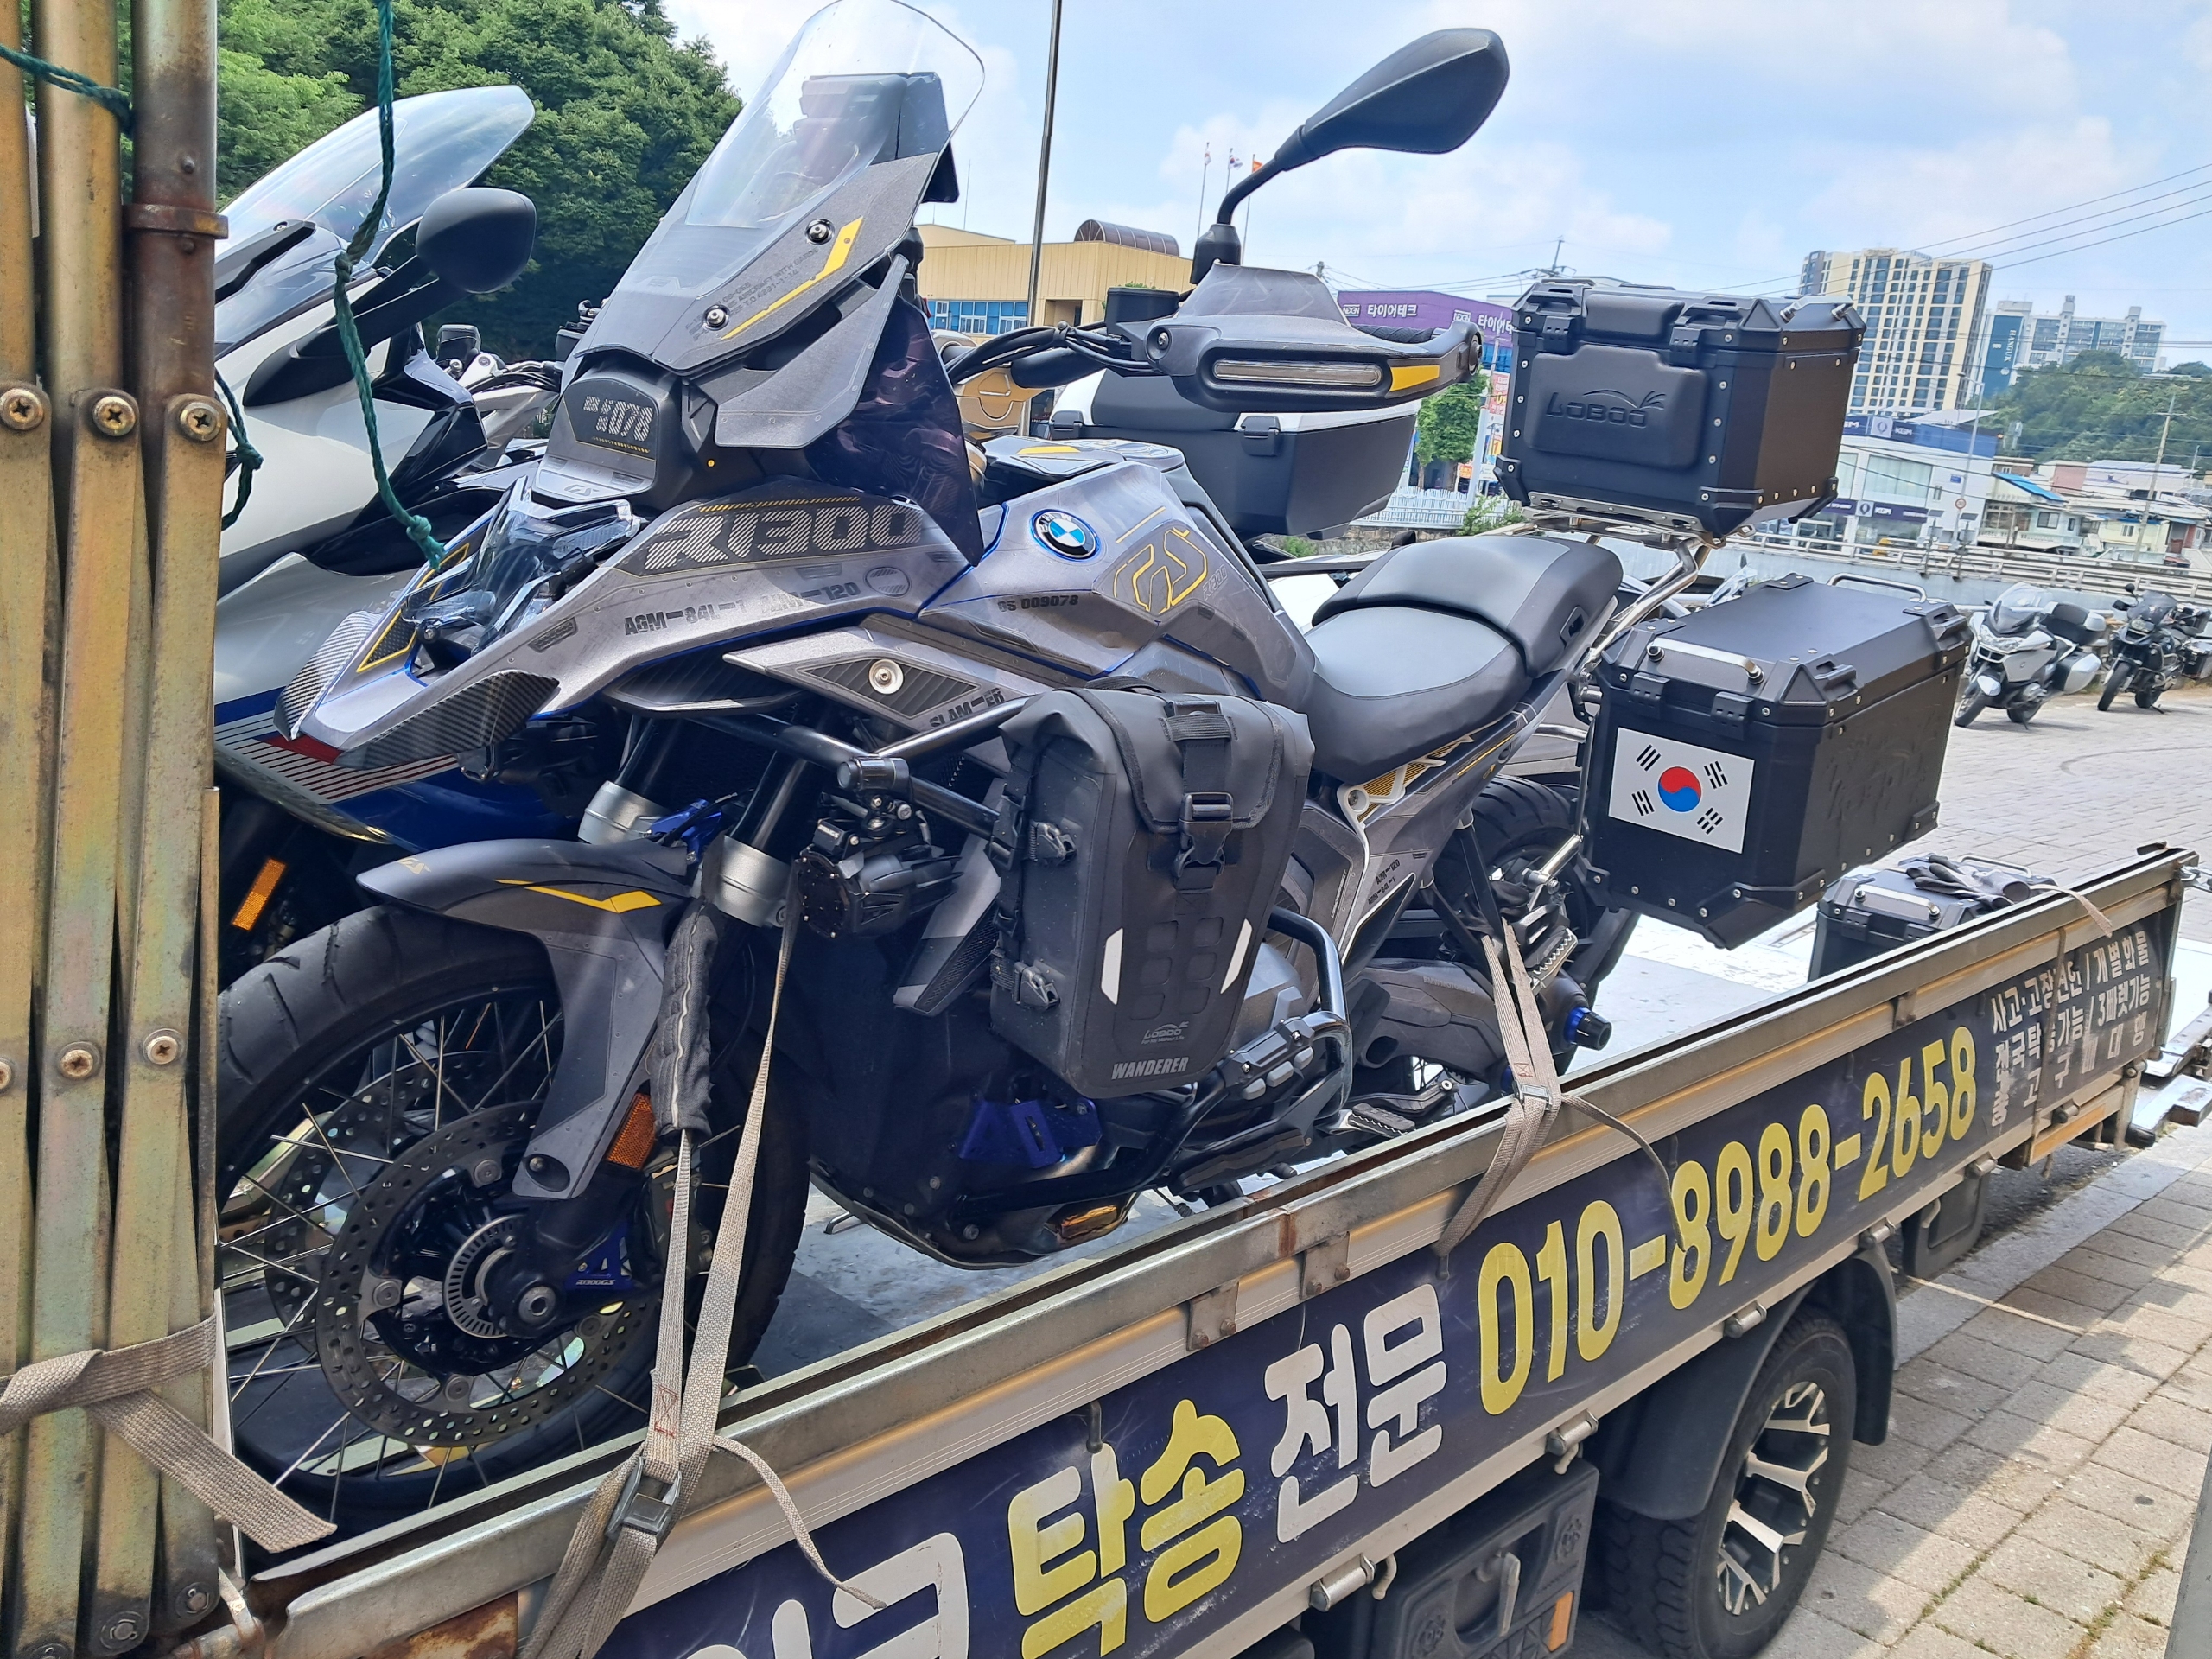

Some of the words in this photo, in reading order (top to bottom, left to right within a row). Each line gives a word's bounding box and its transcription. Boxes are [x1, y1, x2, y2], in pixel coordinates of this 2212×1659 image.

[1367, 305, 1417, 318] 타이어테크
[645, 505, 923, 570] R1300
[1021, 594, 1079, 610] 009078
[1111, 1057, 1190, 1080] WANDERER
[1007, 1398, 1245, 1659] 탁송
[1264, 1282, 1449, 1544] 전문
[1478, 1026, 1977, 1415] 010-8988-2658
